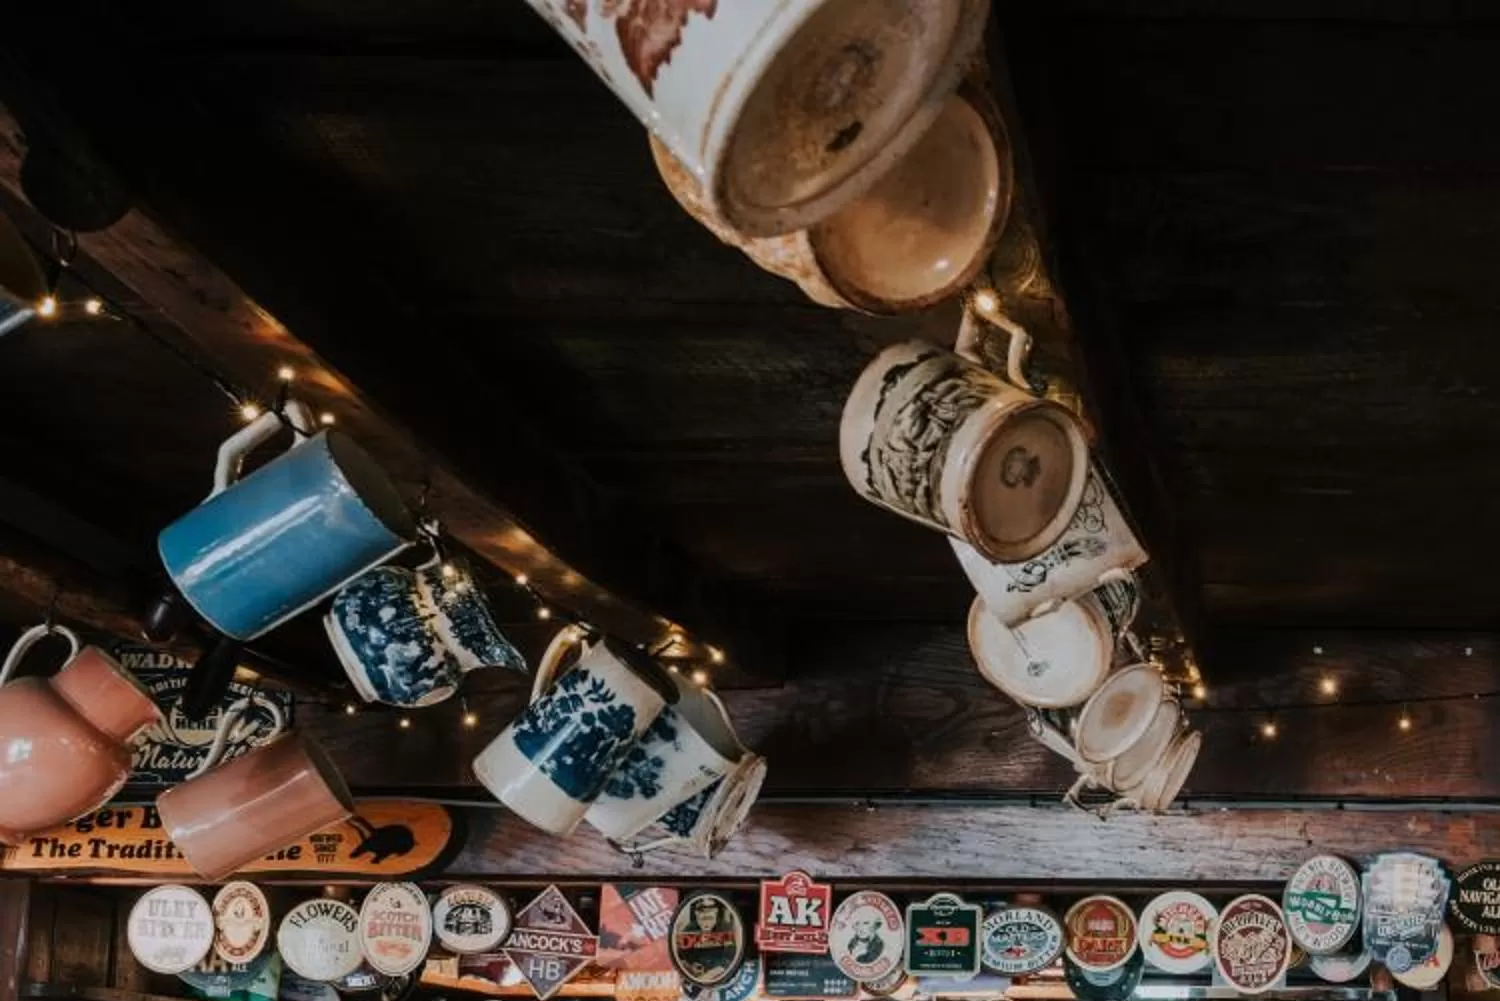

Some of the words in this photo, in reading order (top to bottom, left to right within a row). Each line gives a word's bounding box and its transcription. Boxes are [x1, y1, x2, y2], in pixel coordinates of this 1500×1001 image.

[30, 837, 82, 858] The
[88, 838, 186, 860] Tradit
[288, 903, 359, 933] FLOWERS
[370, 910, 419, 922] SCOTCH
[767, 895, 823, 927] AK
[983, 909, 1055, 931] MORLAND
[367, 923, 423, 942] BITTER
[504, 933, 584, 953] ANCOCK'S
[529, 958, 561, 981] HB
